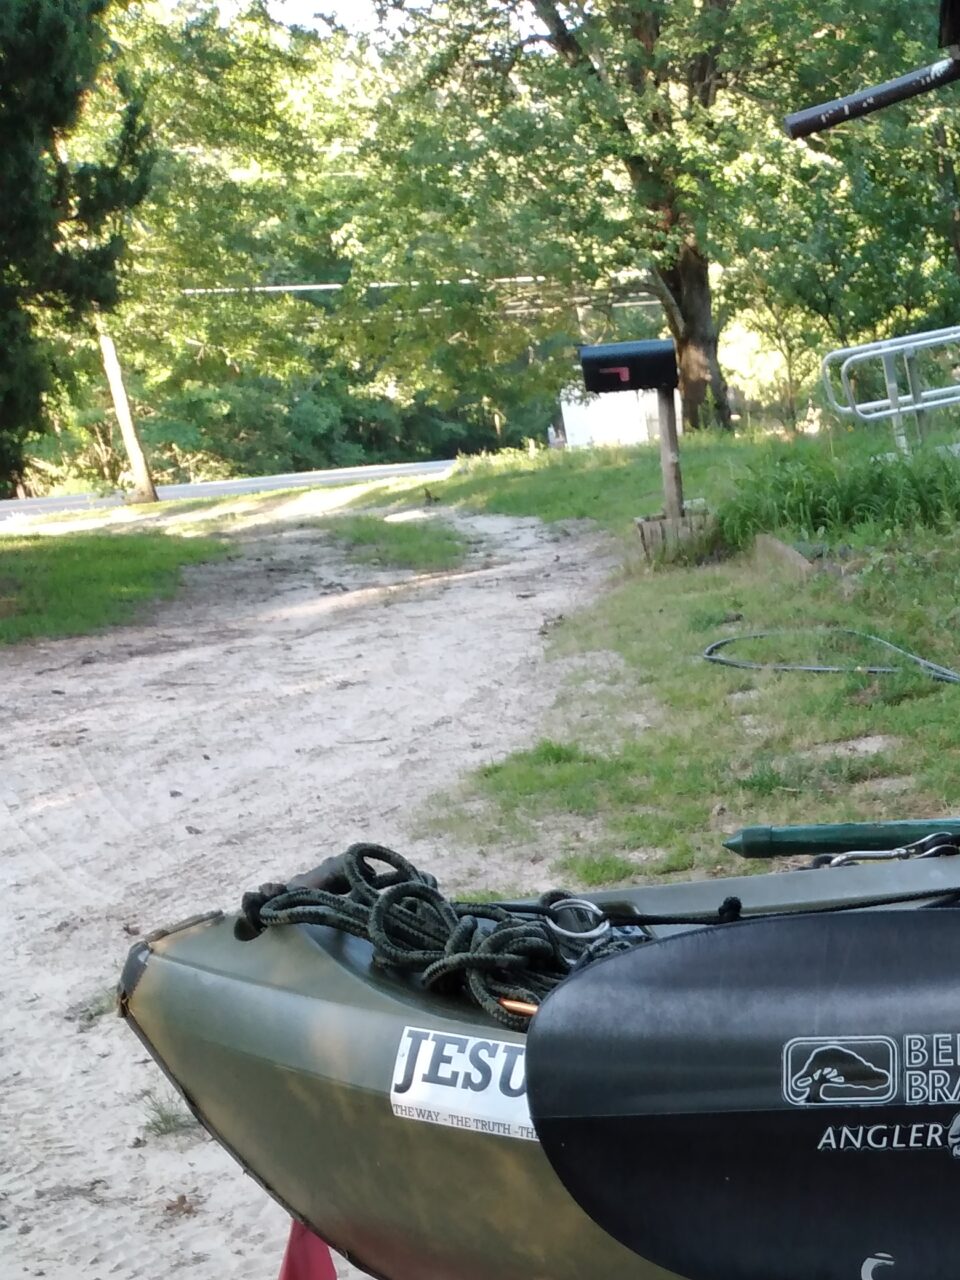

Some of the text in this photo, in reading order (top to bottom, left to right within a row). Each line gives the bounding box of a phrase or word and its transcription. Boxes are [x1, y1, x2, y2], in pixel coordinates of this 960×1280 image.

[393, 1104, 415, 1117] THE
[414, 1107, 441, 1122] WAY
[448, 1114, 471, 1128] THE
[473, 1119, 511, 1135] TRUTH
[817, 1124, 943, 1150] ANGLER
